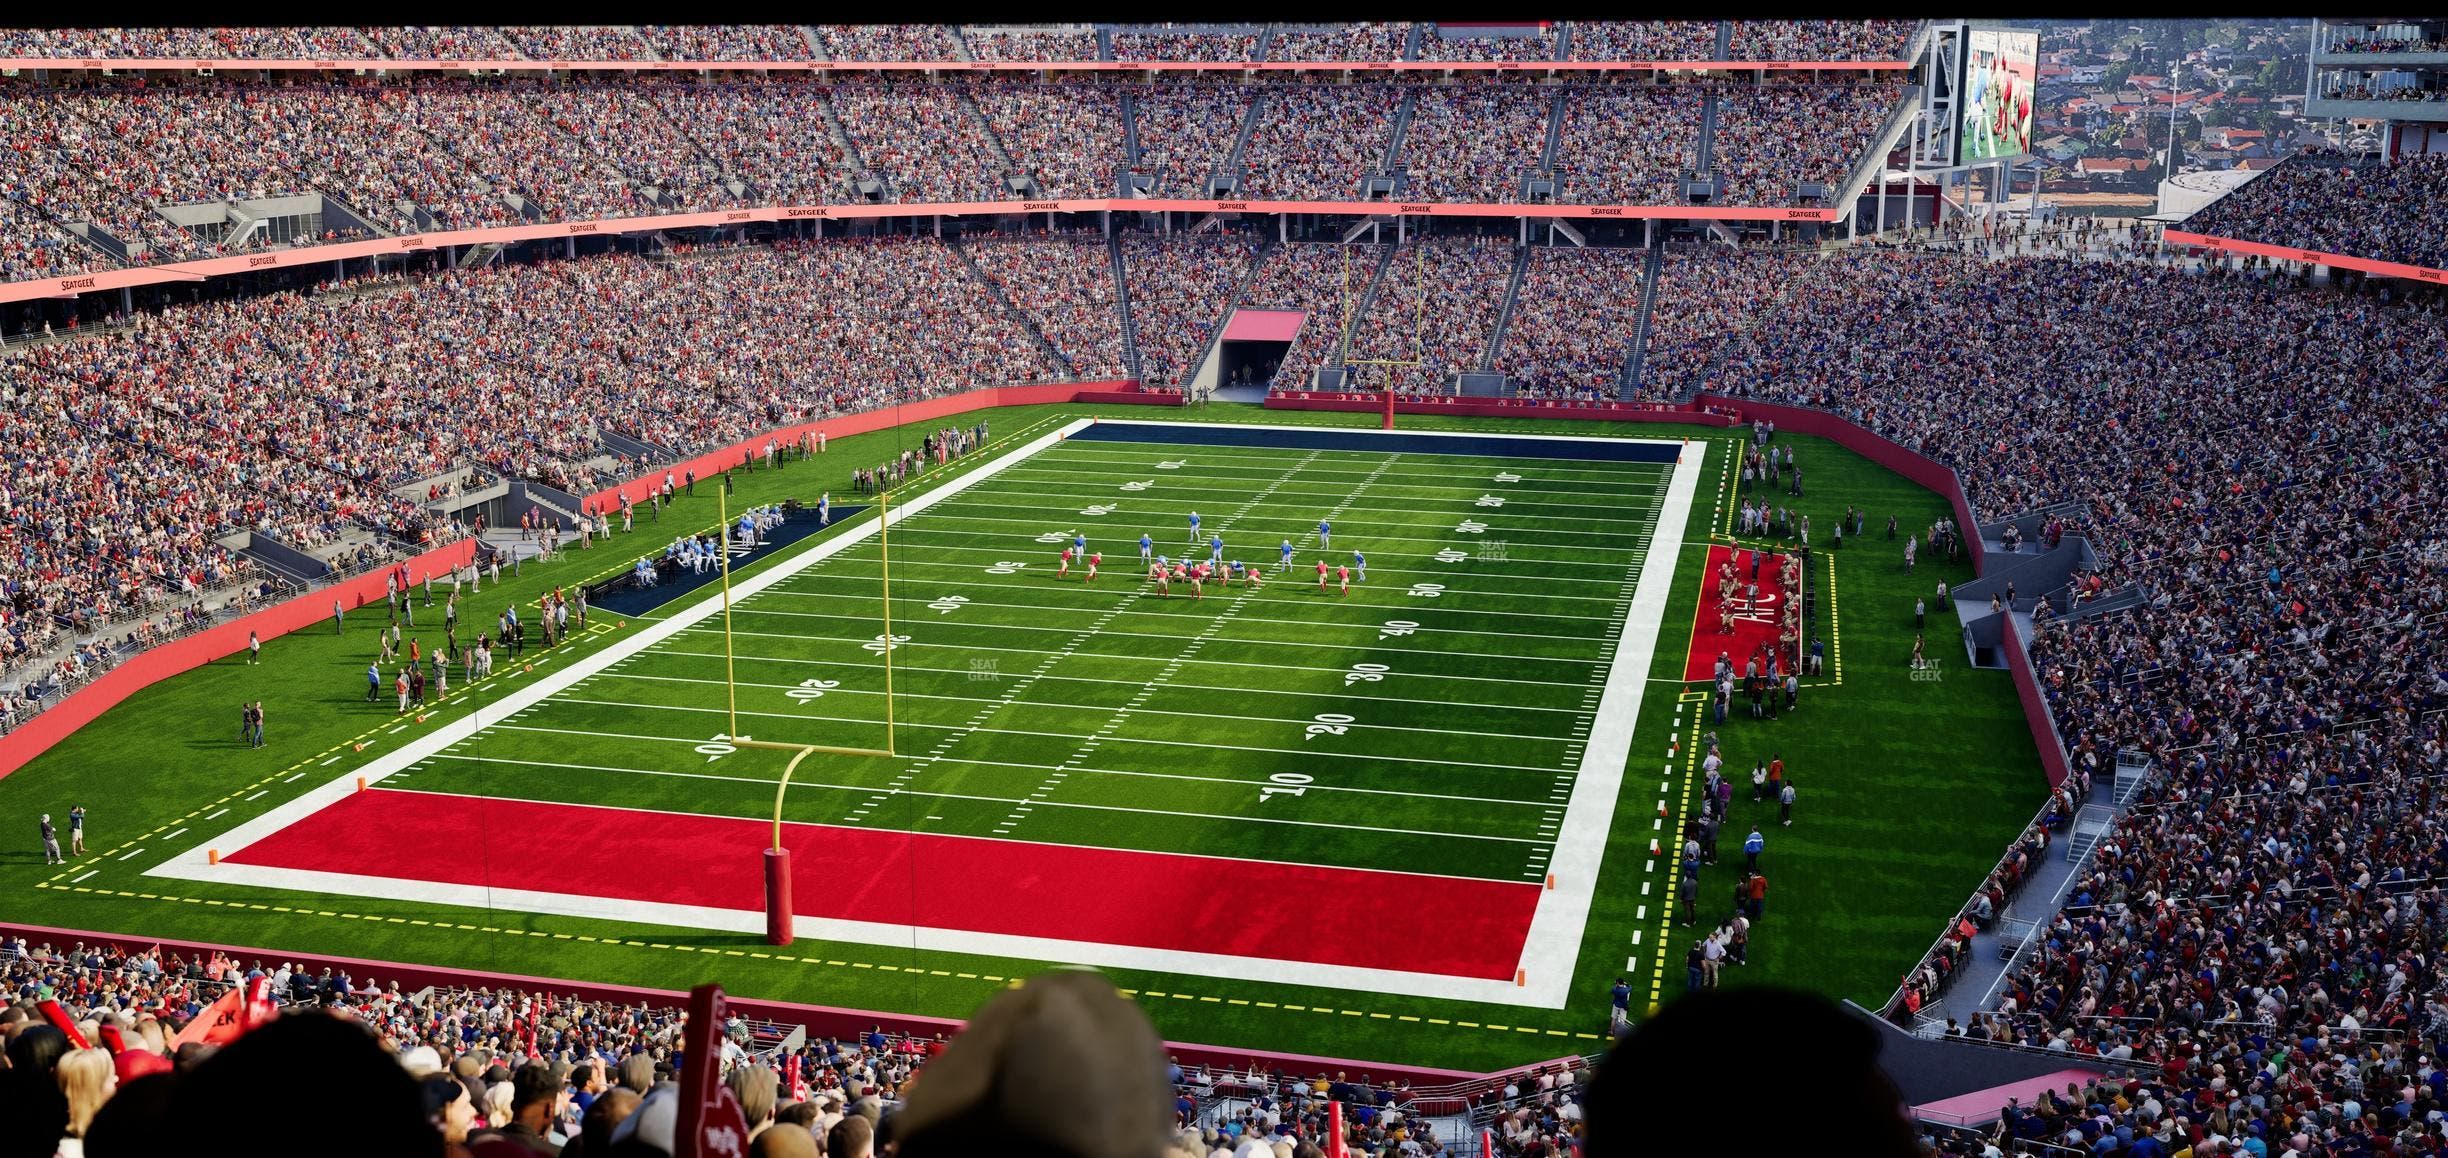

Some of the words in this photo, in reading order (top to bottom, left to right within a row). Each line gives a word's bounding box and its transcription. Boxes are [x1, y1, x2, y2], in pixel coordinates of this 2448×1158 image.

[1023, 202, 1059, 211] SEATGEEK
[1218, 202, 1247, 211] SEATGEEK
[1401, 205, 1431, 213] SEATGEEK
[1591, 207, 1622, 216] SEATGEEK
[727, 212, 750, 221] SEATGEEK
[788, 208, 827, 217] SEATGEEK
[1788, 210, 1821, 219] SEATGEEK
[569, 223, 597, 233] SEATGEEK
[401, 237, 424, 248] SEATGEEK
[250, 255, 276, 268] SEATGEEK
[2419, 270, 2441, 281] SEATGEEK
[61, 277, 95, 291] SEATGEEK
[1407, 583, 1446, 598] 50
[1380, 620, 1420, 637] 40
[1345, 663, 1390, 682] 30
[785, 678, 841, 698] 20
[1305, 713, 1356, 735] 20
[1261, 772, 1314, 797] 10
